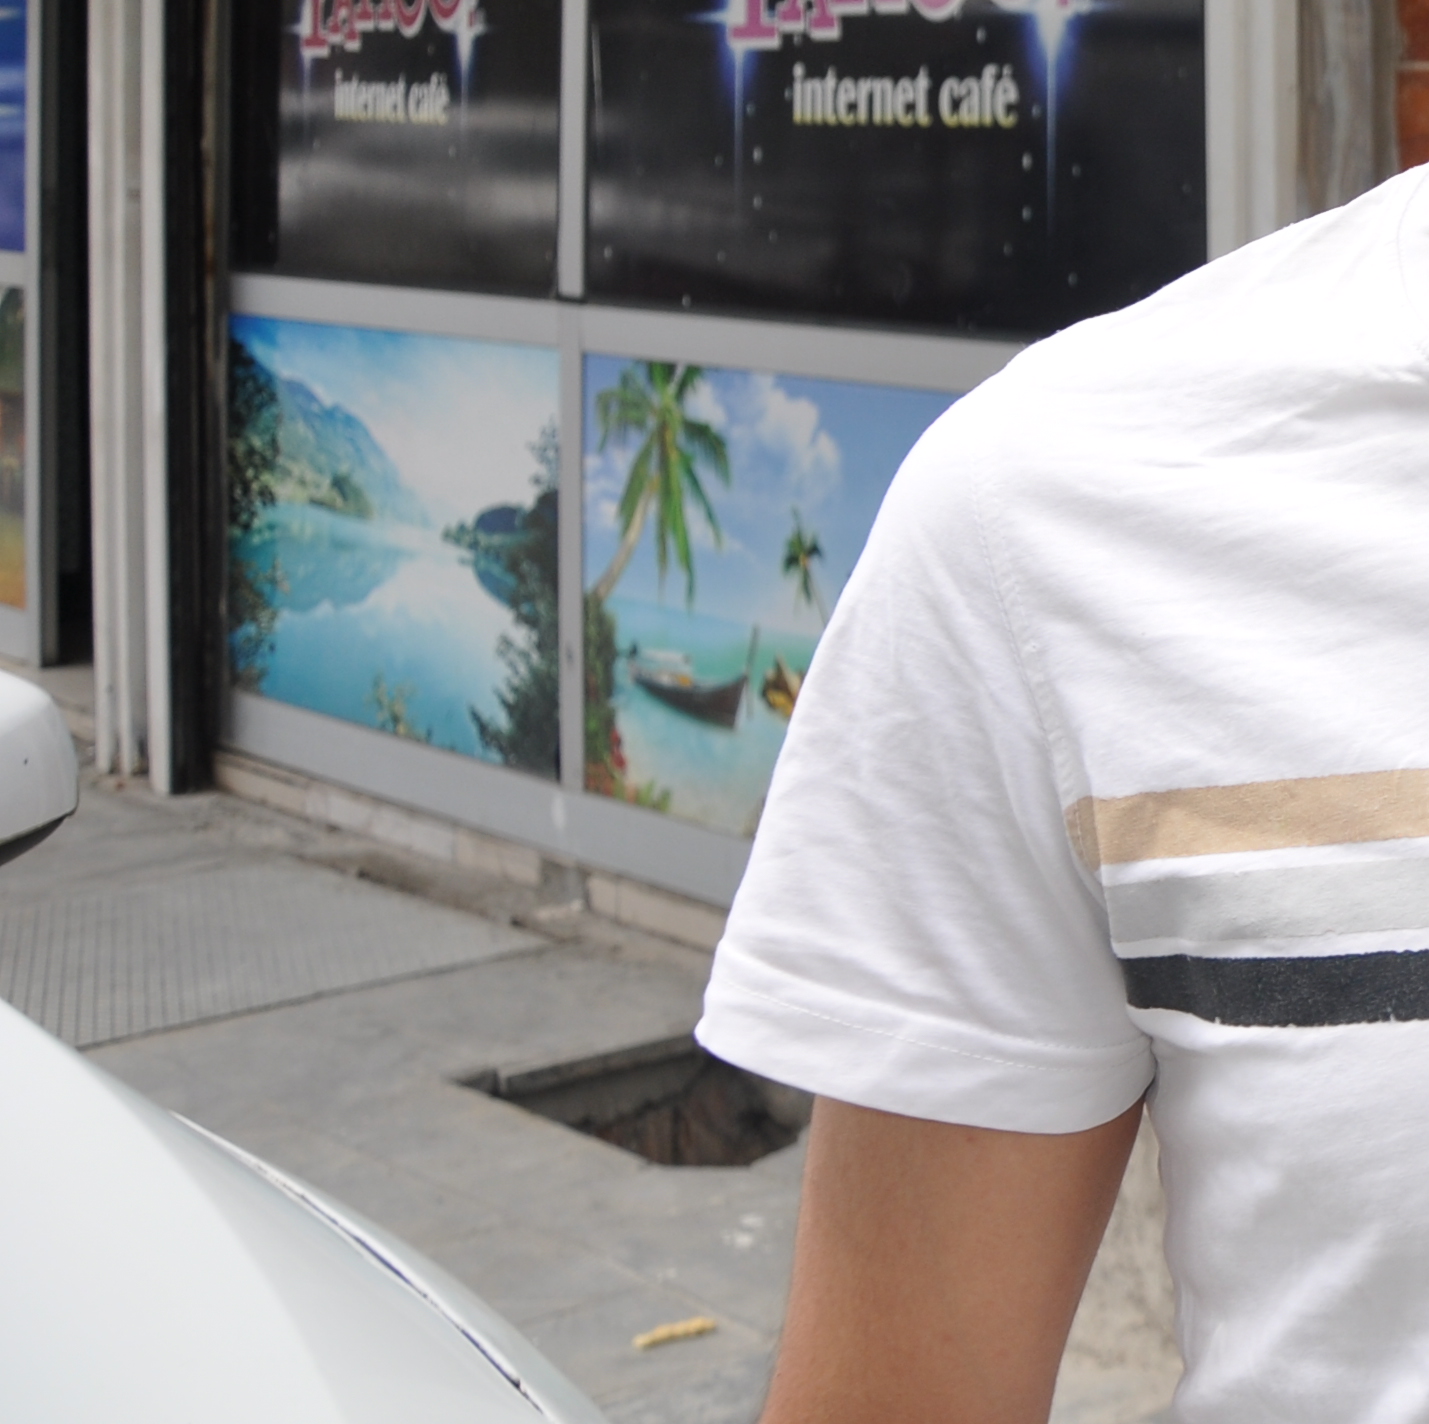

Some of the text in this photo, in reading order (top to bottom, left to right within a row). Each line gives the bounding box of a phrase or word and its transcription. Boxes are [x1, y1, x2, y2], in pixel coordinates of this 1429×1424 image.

[333, 67, 451, 126] internet café
[792, 60, 1020, 128] internet café
